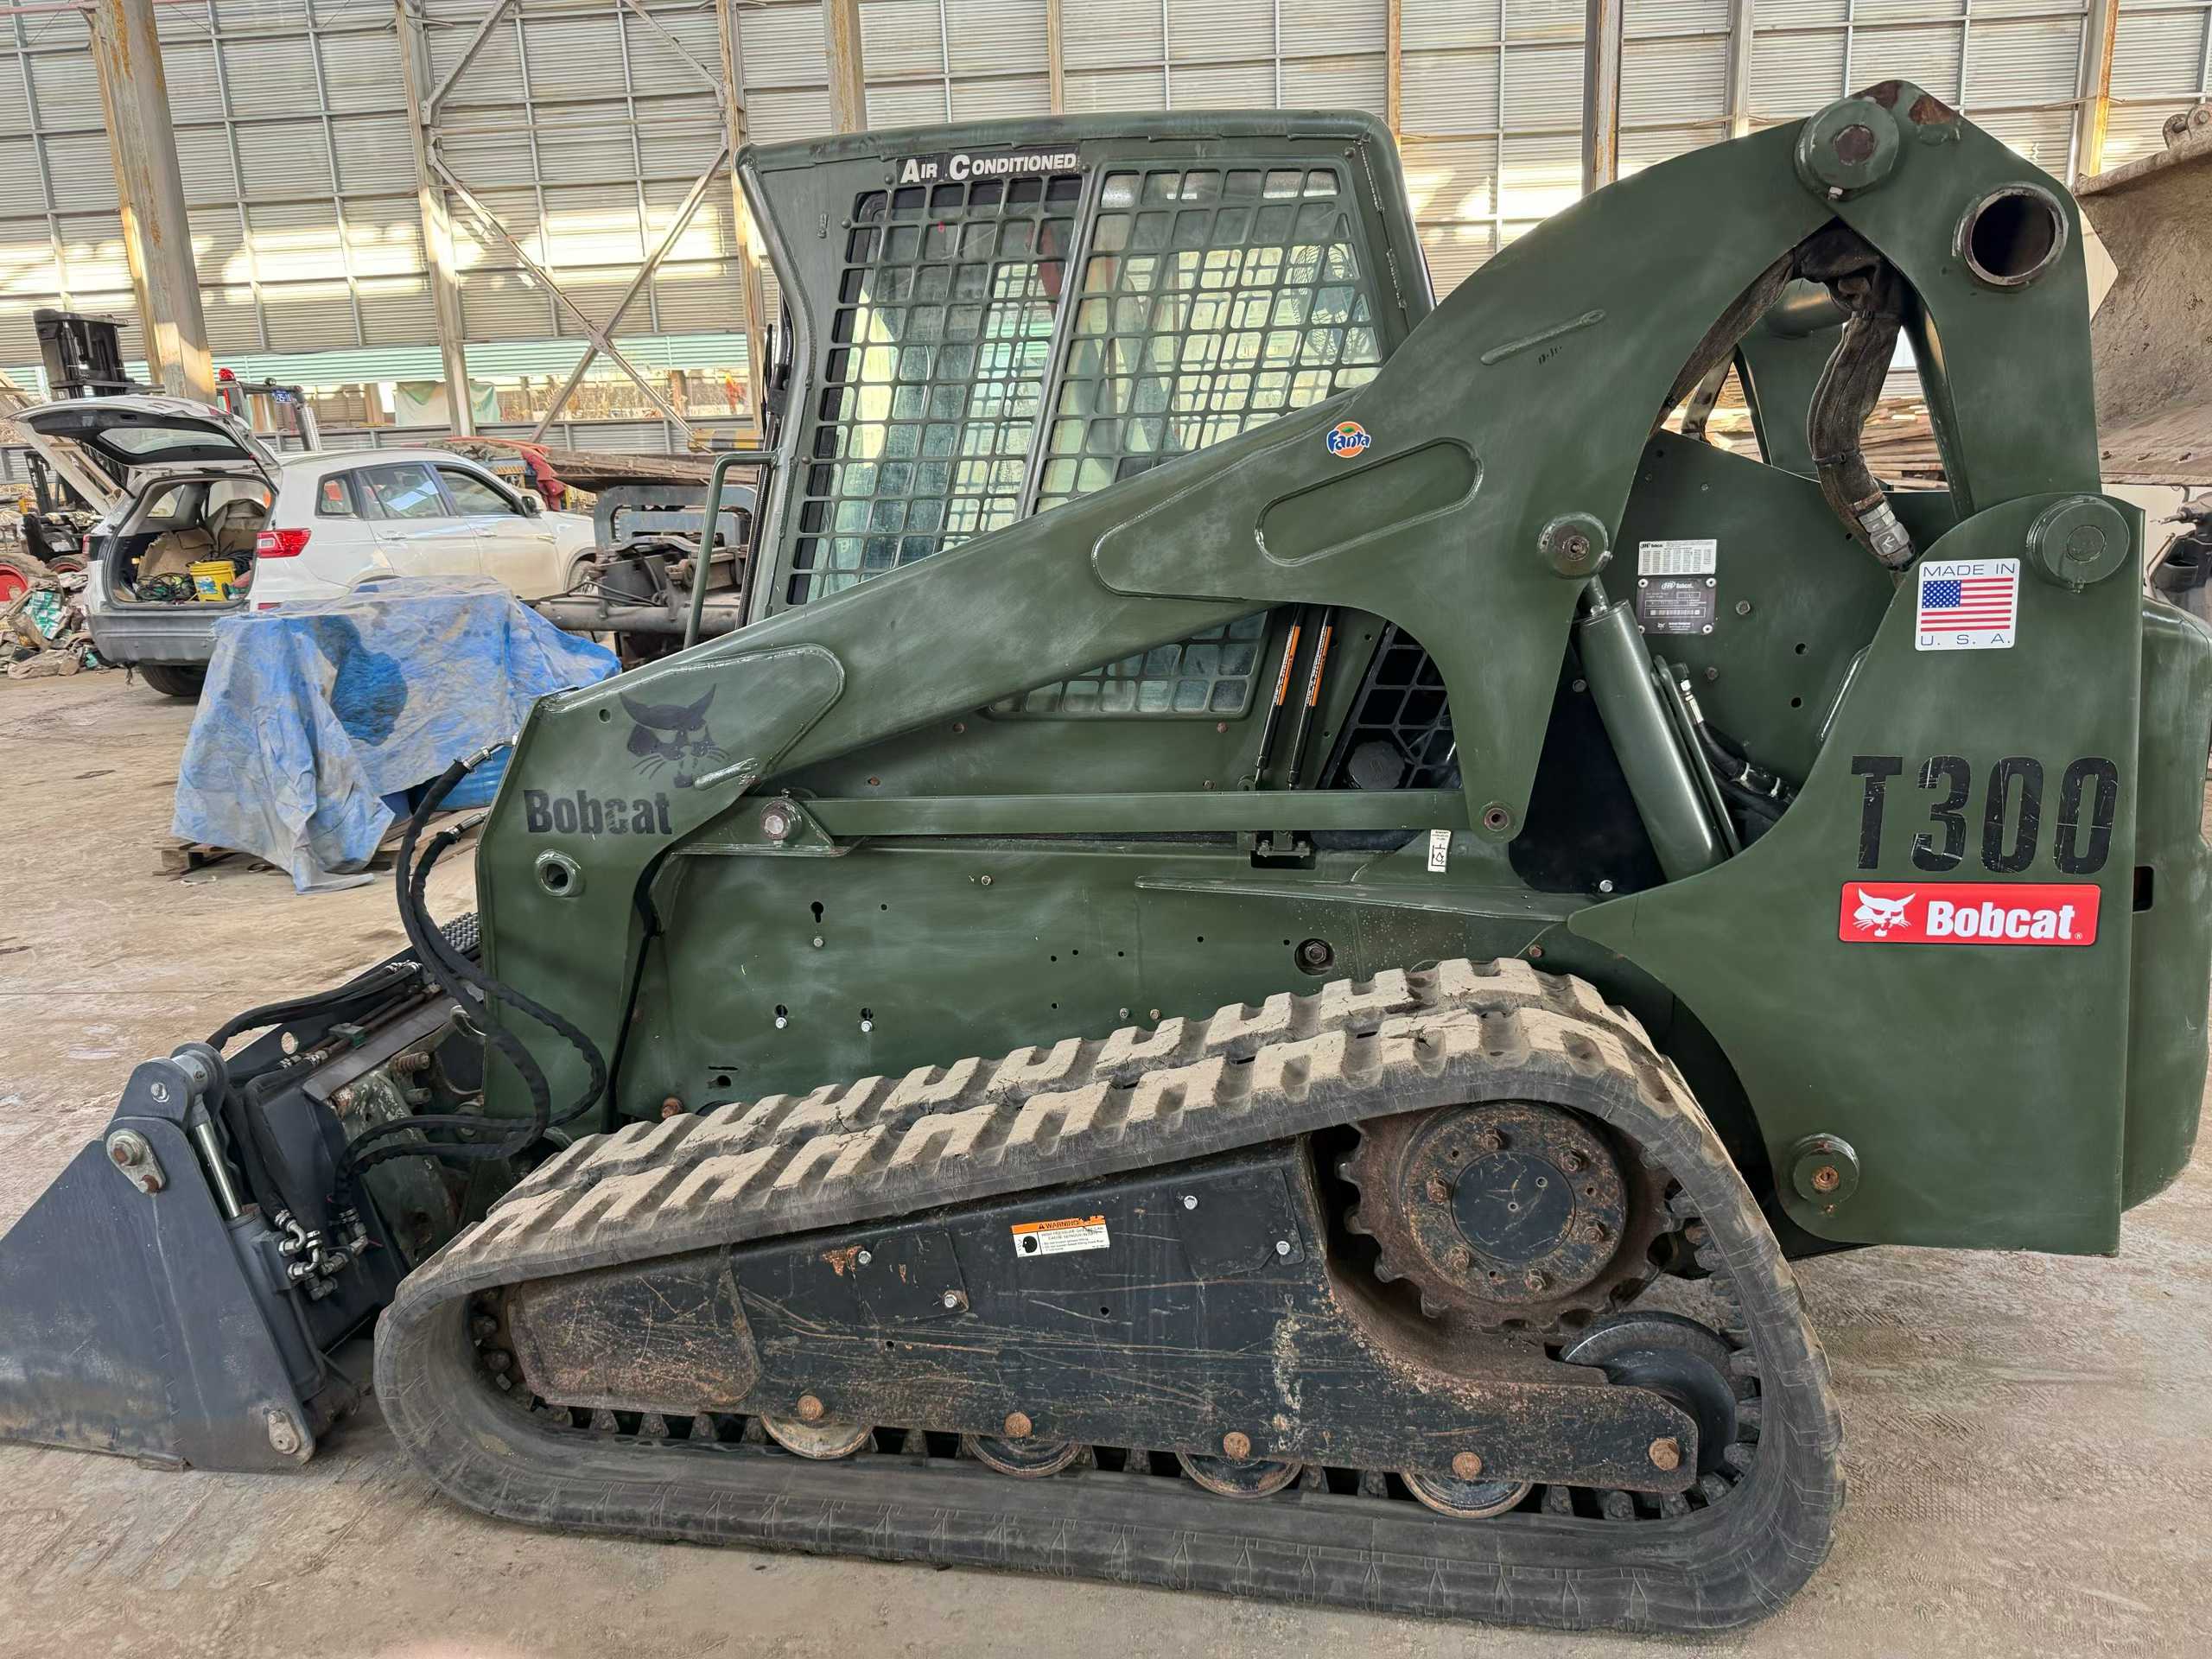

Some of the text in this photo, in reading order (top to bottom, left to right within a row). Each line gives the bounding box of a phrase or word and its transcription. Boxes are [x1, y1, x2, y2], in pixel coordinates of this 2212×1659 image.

[1326, 429, 1371, 454] Fanta
[1923, 563, 2016, 576] MADE IN
[524, 790, 672, 836] Bobcat
[1851, 755, 2119, 874] T300
[1926, 900, 2075, 940] Bobcat
[1046, 1219, 1079, 1230] WARNING
